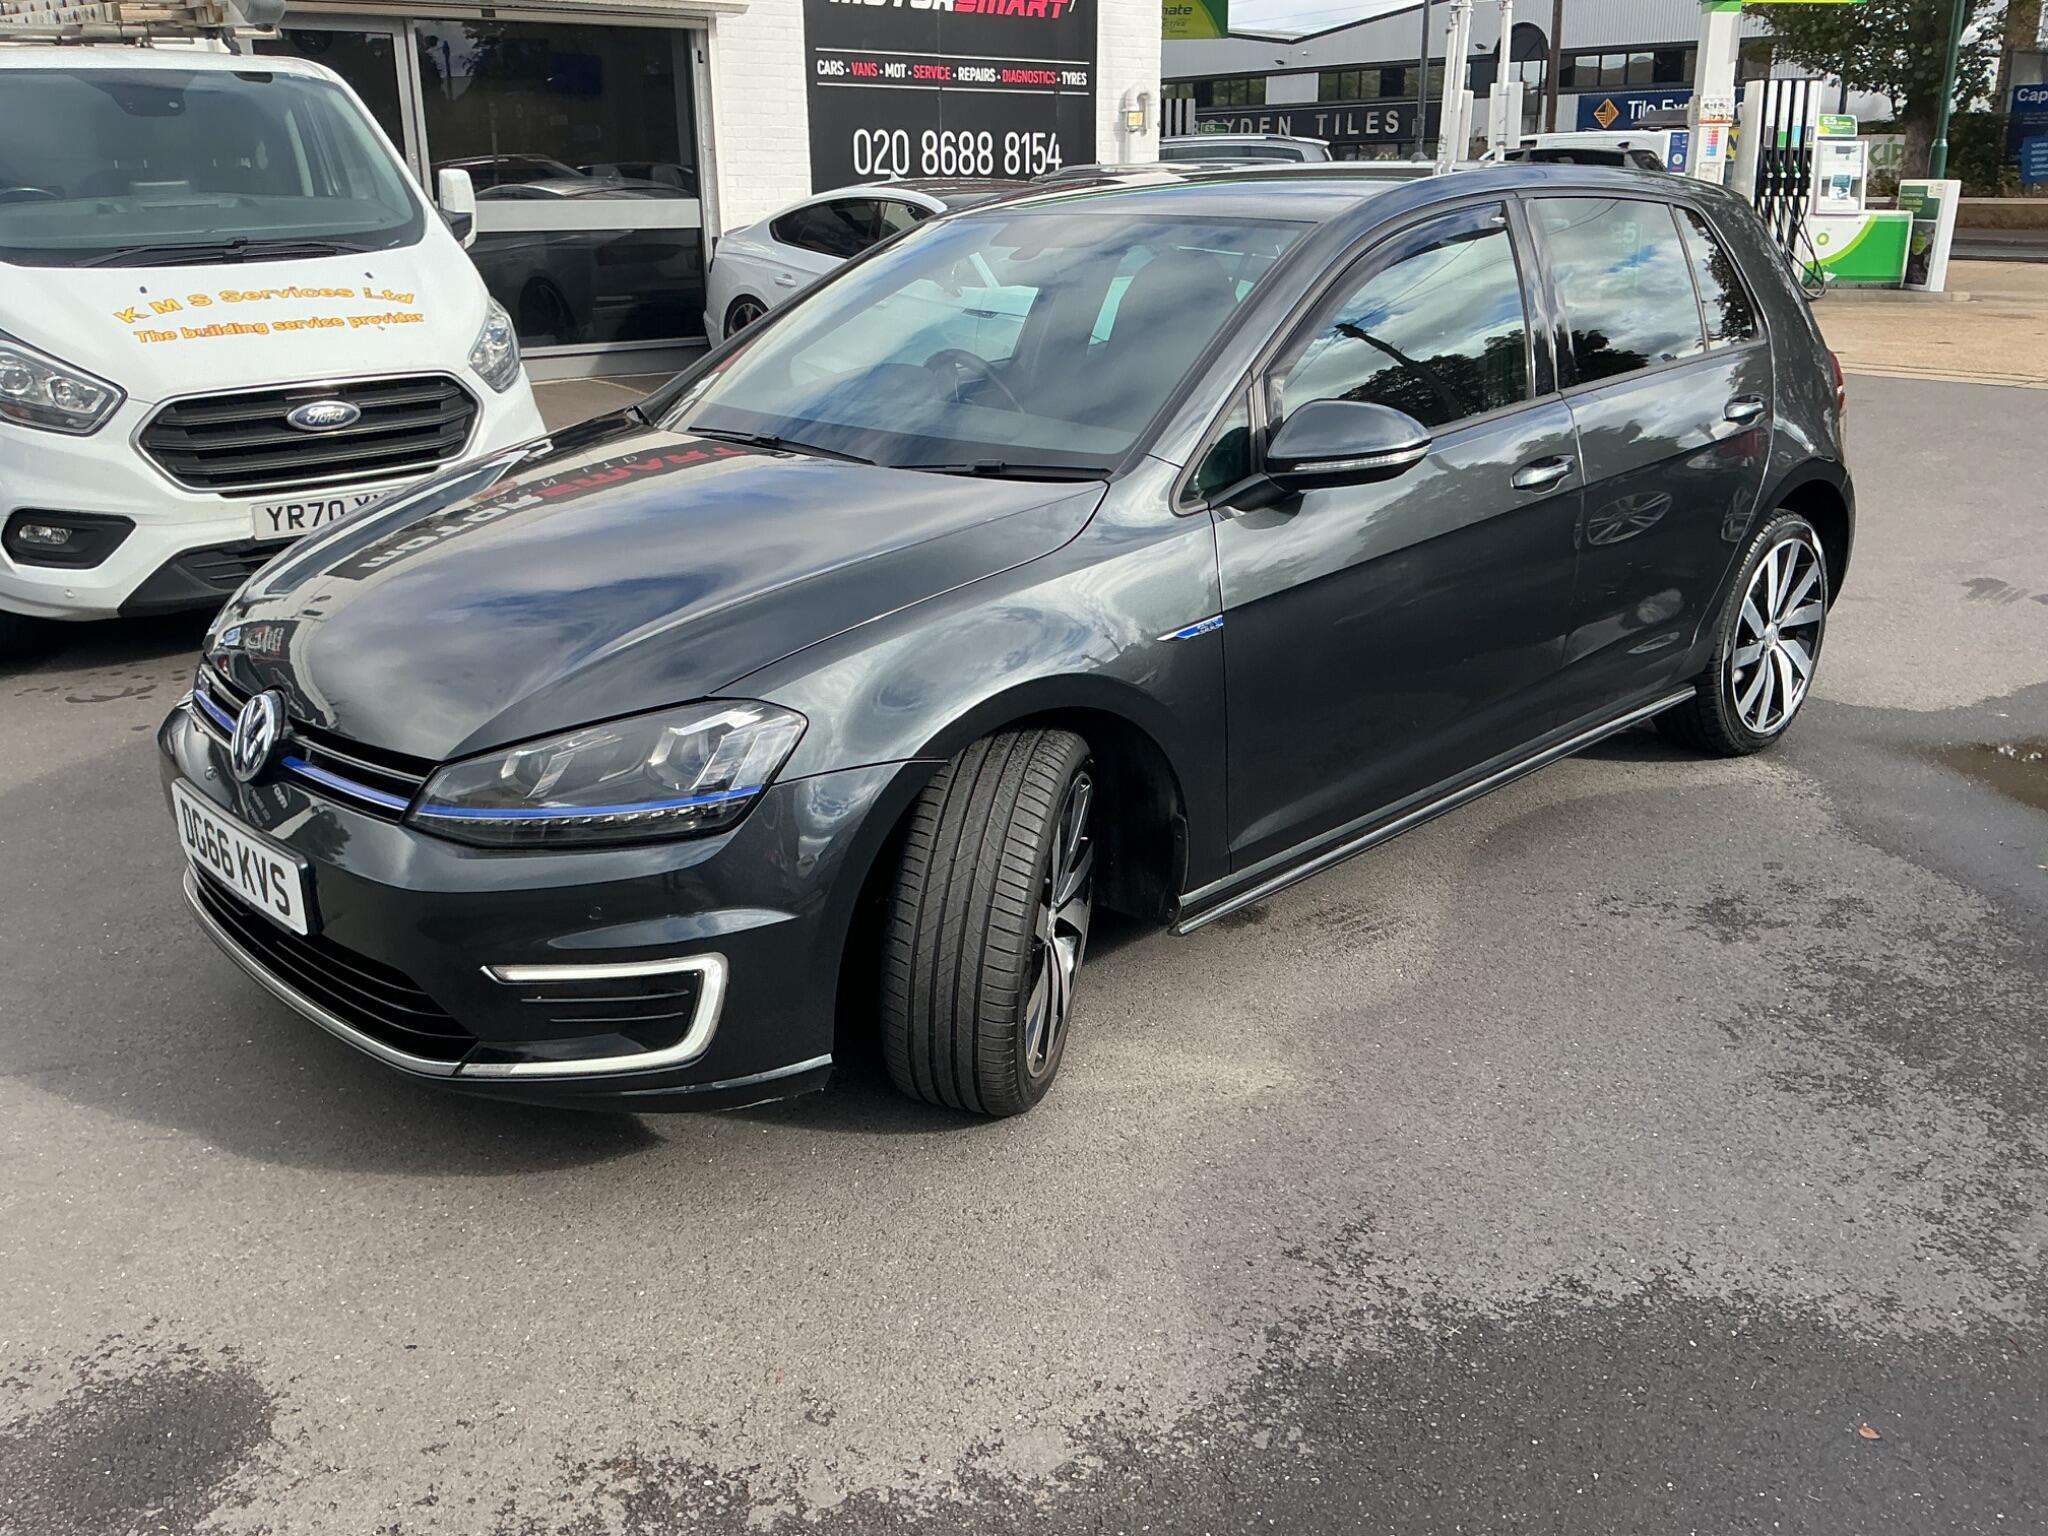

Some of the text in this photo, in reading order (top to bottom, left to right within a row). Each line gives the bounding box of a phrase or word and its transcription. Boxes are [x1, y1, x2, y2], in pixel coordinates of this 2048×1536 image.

[829, 0, 1068, 19] RSMART
[817, 60, 1088, 85] CARS VANS MOT SERVICE REPAIRS DIAGNOSTICS TYRES
[1192, 110, 1399, 137] YDEN TILES
[853, 129, 1062, 176] 020 8688 8154
[113, 286, 415, 324] K M S Services Ltd
[133, 312, 424, 343] The building service provider
[305, 406, 346, 424] Ford
[266, 500, 346, 532] YR70
[236, 840, 292, 917] KVS
